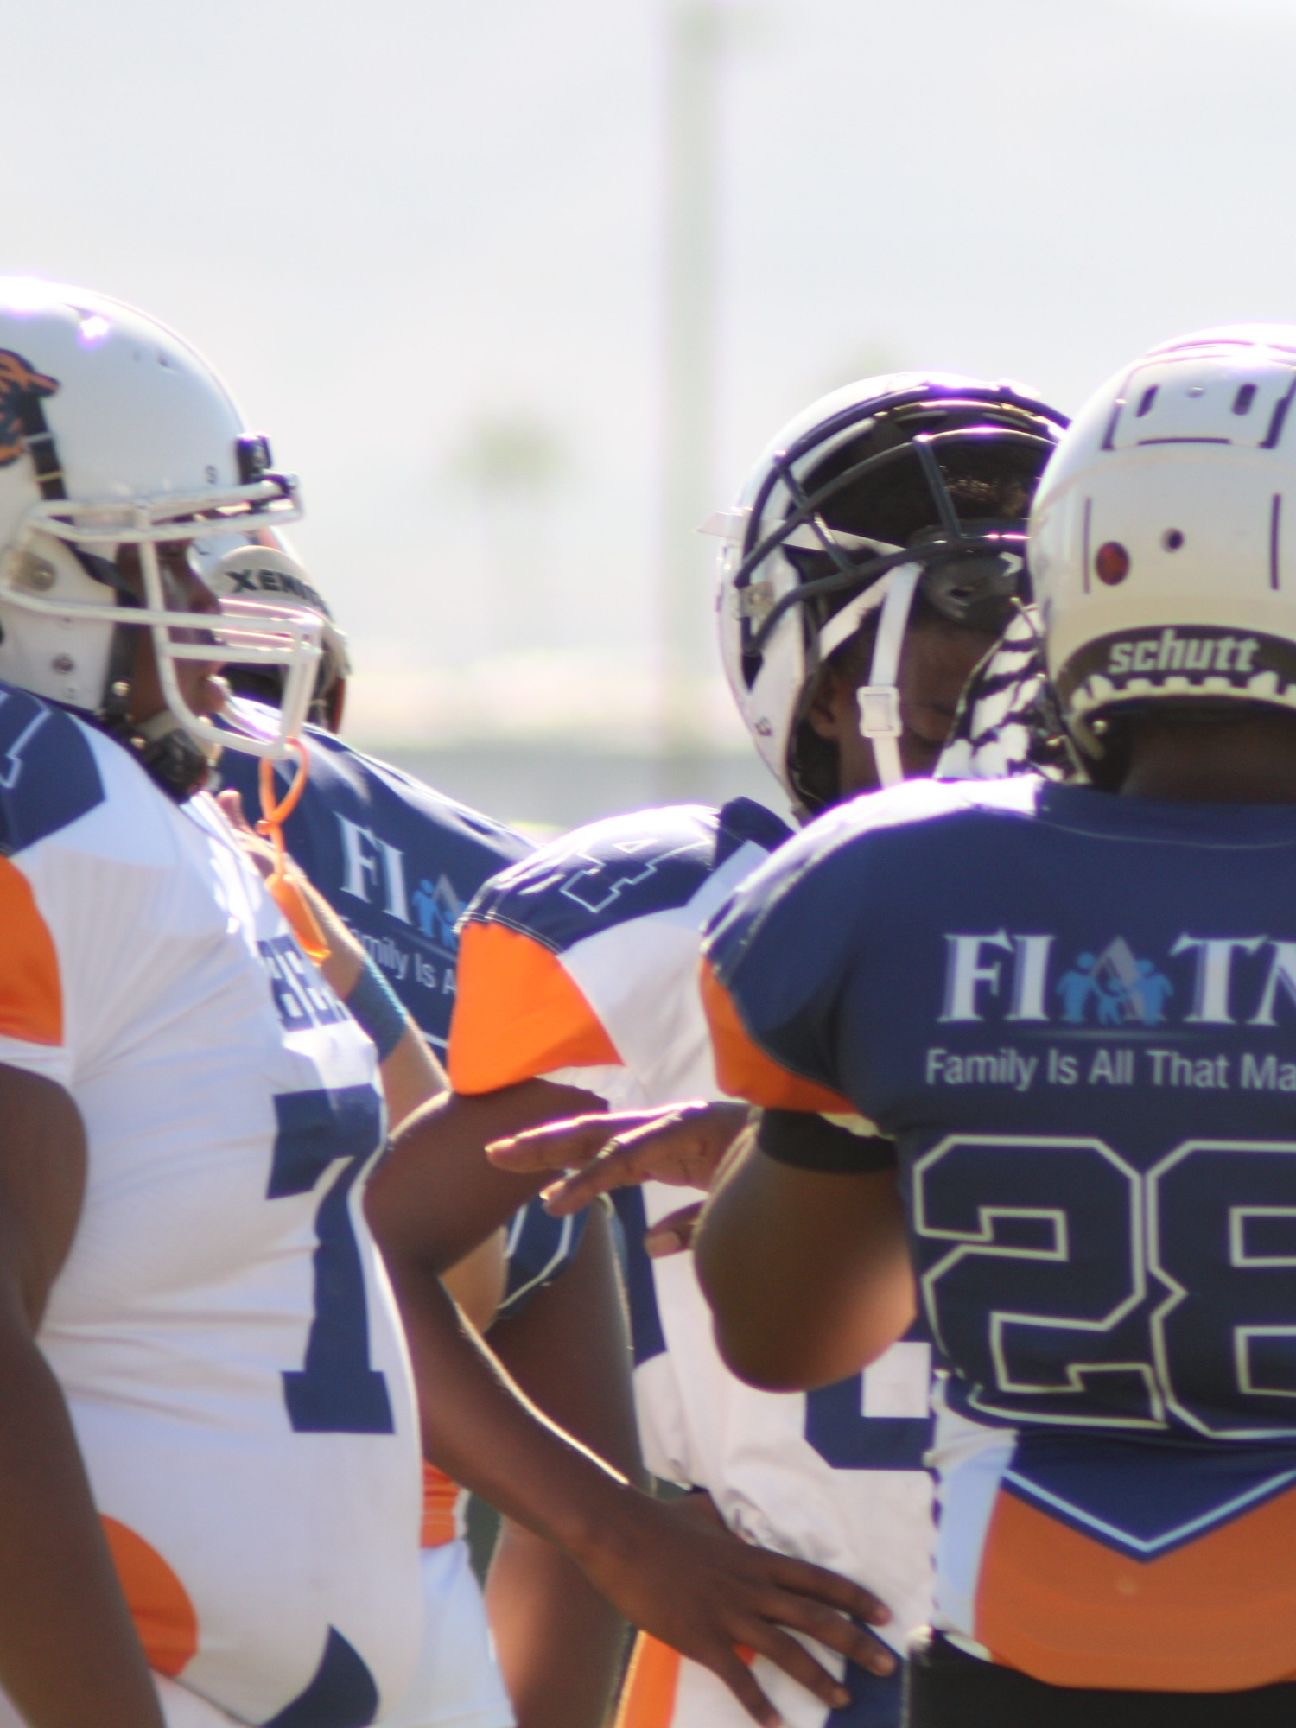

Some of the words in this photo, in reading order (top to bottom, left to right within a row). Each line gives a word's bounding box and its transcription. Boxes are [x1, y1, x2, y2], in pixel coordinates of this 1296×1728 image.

[1107, 627, 1261, 675] schutt
[414, 952, 446, 988] Is
[925, 1047, 1039, 1092] Family
[1048, 1048, 1079, 1085] Is
[1088, 1049, 1135, 1086] All
[1146, 1049, 1229, 1089] That
